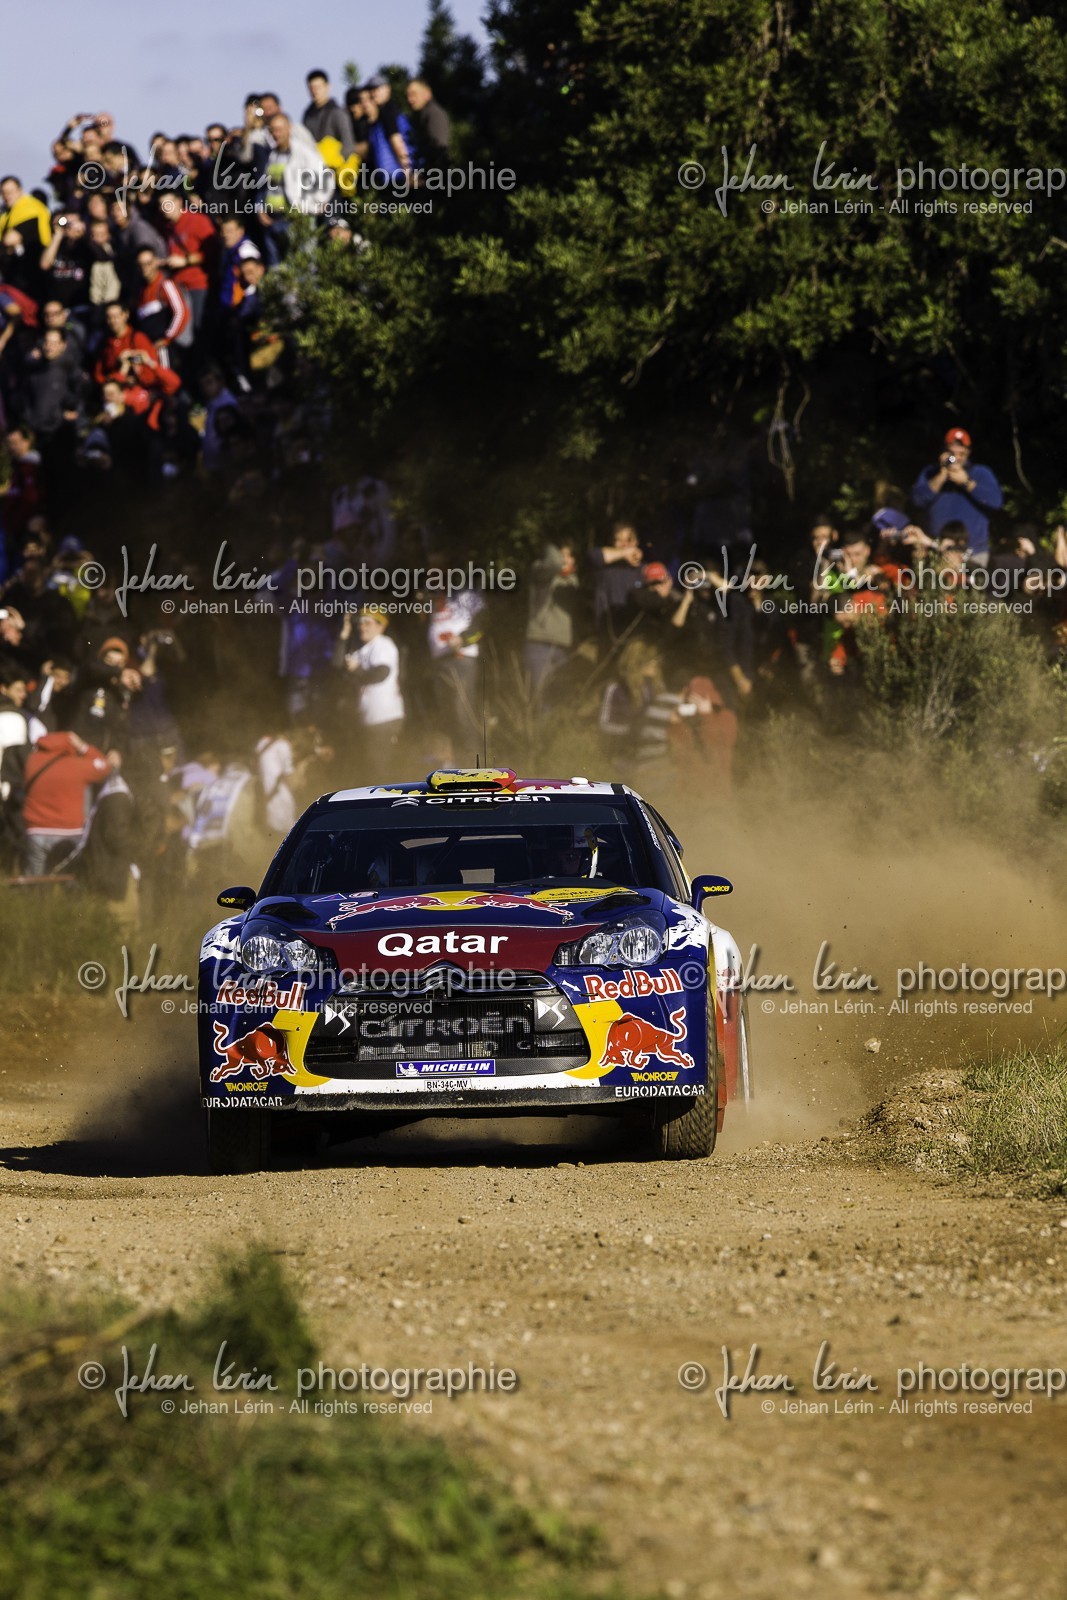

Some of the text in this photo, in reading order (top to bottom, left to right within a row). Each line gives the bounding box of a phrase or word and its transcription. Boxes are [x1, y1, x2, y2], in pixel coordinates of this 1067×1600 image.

[377, 931, 509, 957] Qatar
[421, 1063, 490, 1072] MICHELIN
[630, 1072, 679, 1082] MONROE
[225, 1082, 268, 1092] MONROE
[615, 1085, 705, 1097] EURODATACAR
